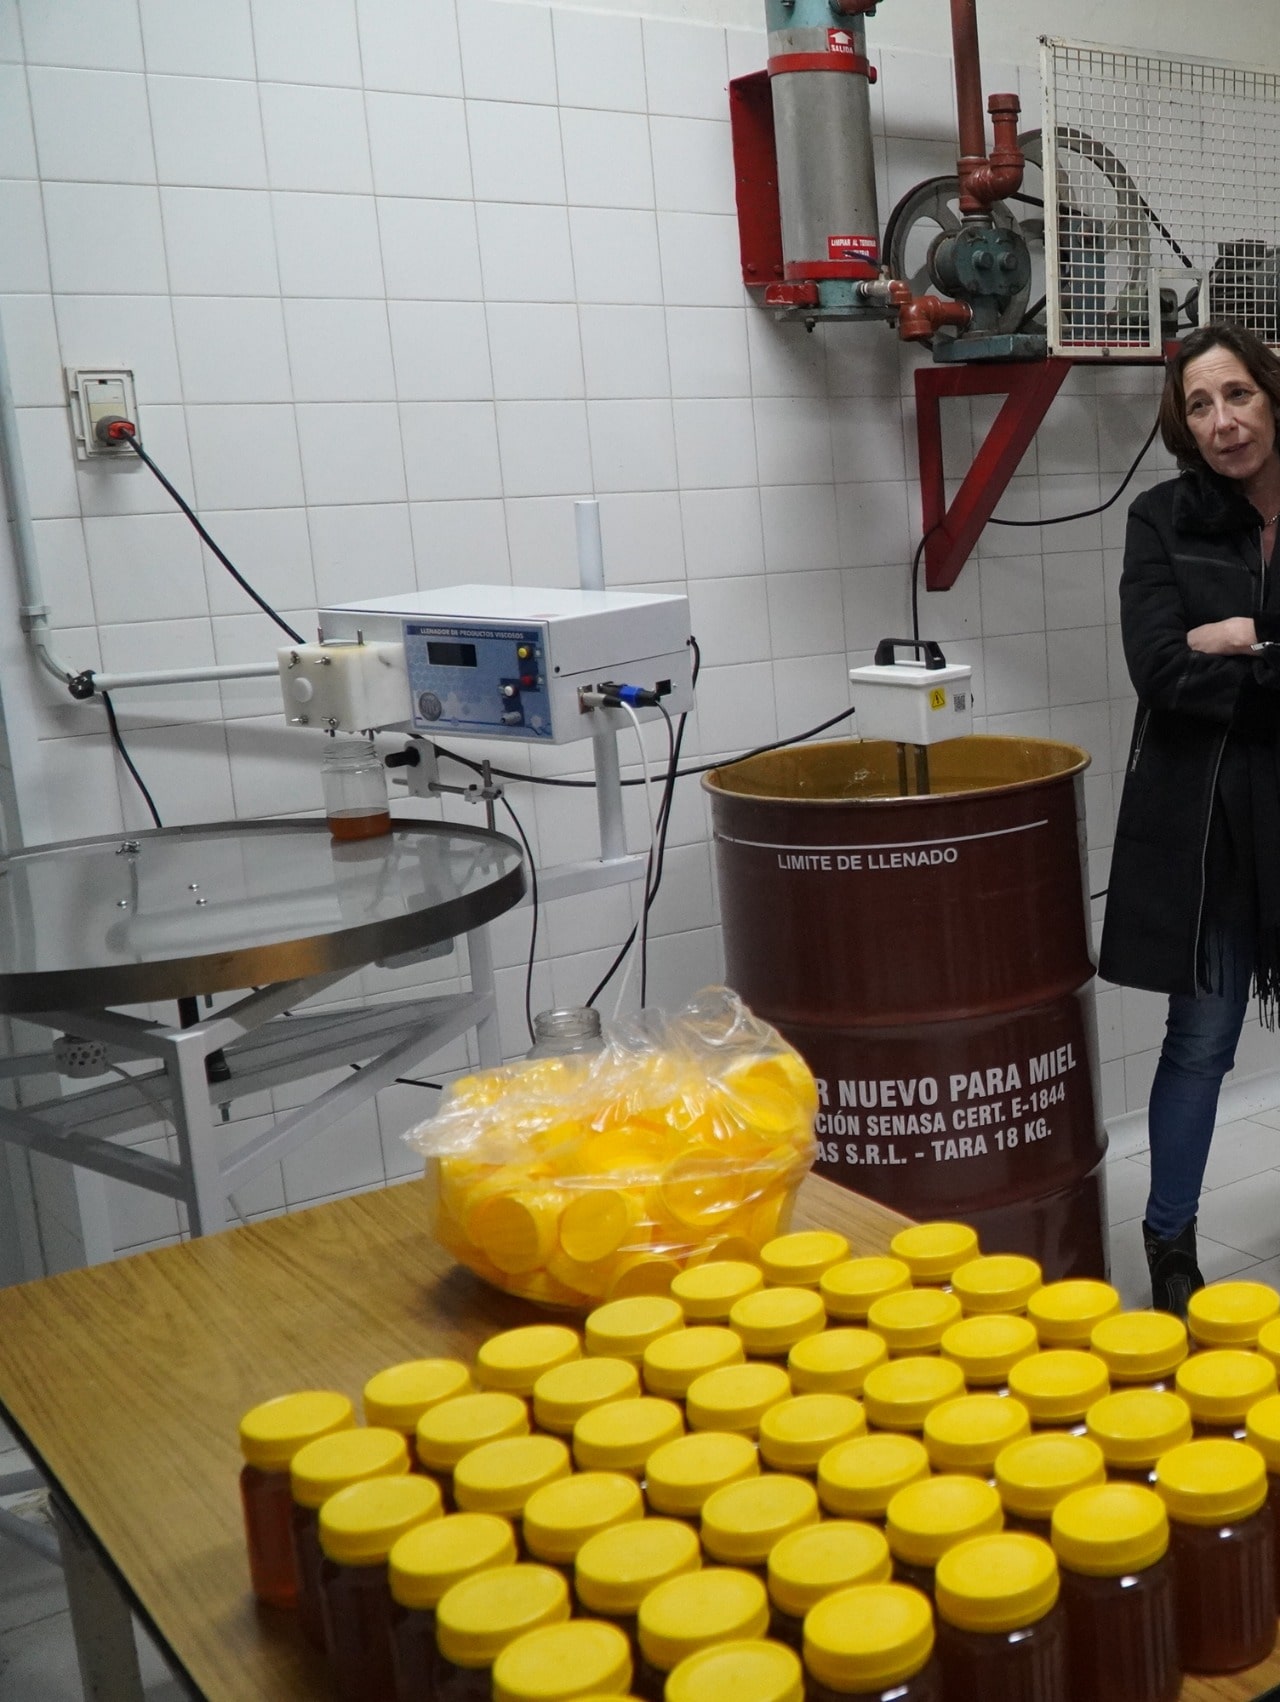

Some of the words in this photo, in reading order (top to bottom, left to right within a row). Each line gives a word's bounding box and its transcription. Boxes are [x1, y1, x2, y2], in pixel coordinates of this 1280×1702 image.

[831, 44, 854, 54] SALIDA
[831, 238, 851, 247] LIMPIAR
[420, 627, 450, 635] LLENADOR
[450, 628, 458, 636] DE
[459, 629, 494, 638] PRODUCTOS
[494, 631, 524, 639] VISCOSOS
[777, 854, 832, 870] LIMITE
[836, 855, 863, 871] DE
[867, 847, 958, 869] LLENADO
[838, 1077, 939, 1108] NUEVO
[949, 1063, 1022, 1102] PARA
[1028, 1042, 1077, 1086] MIEL
[866, 1112, 946, 1136] SENASA
[952, 1102, 1006, 1130] CERT.
[1011, 1081, 1066, 1118] E-1844
[845, 1144, 907, 1165] S.R.L.
[914, 1151, 925, 1159] -
[931, 1134, 988, 1162] TARA
[994, 1127, 1018, 1151] 18
[1024, 1117, 1052, 1144] KG.
